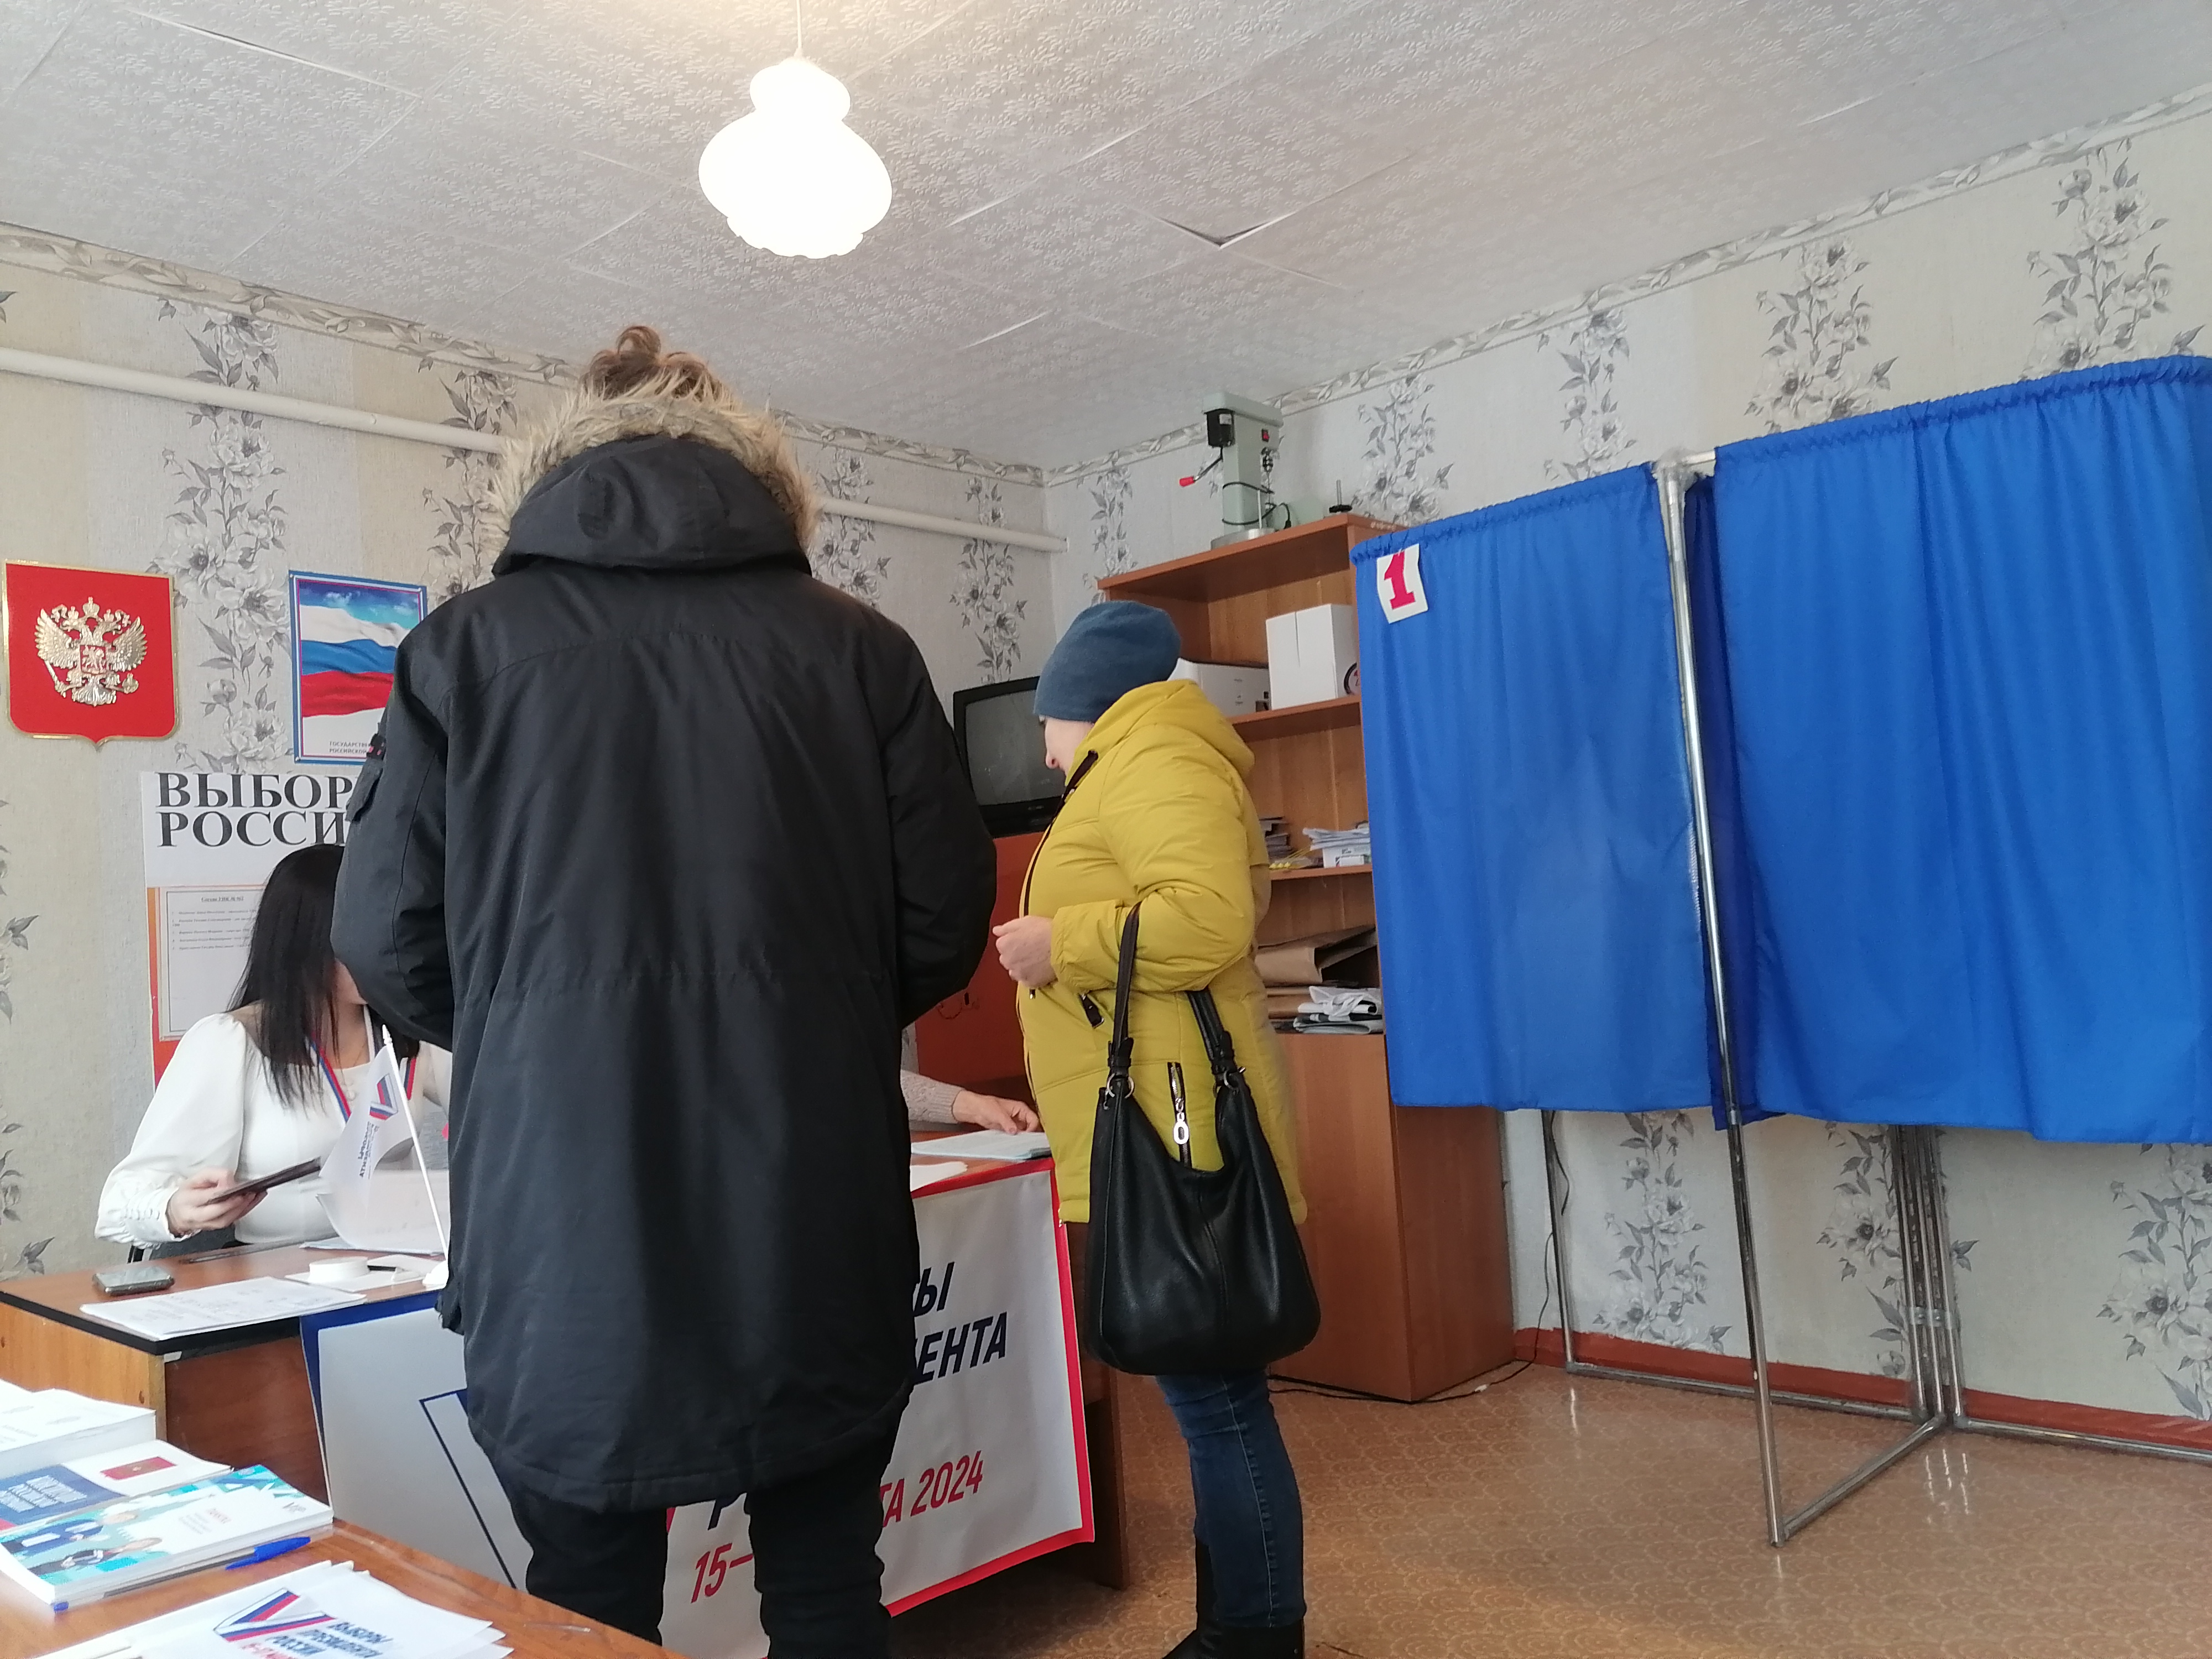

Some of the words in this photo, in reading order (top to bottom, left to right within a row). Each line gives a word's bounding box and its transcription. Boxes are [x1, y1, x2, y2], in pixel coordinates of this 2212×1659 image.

[1384, 551, 1416, 609] 1
[155, 772, 355, 809] ВЫБОР
[155, 810, 346, 847] РОССИ
[914, 1311, 1007, 1386] ЕНТА
[910, 1450, 983, 1517] 2024
